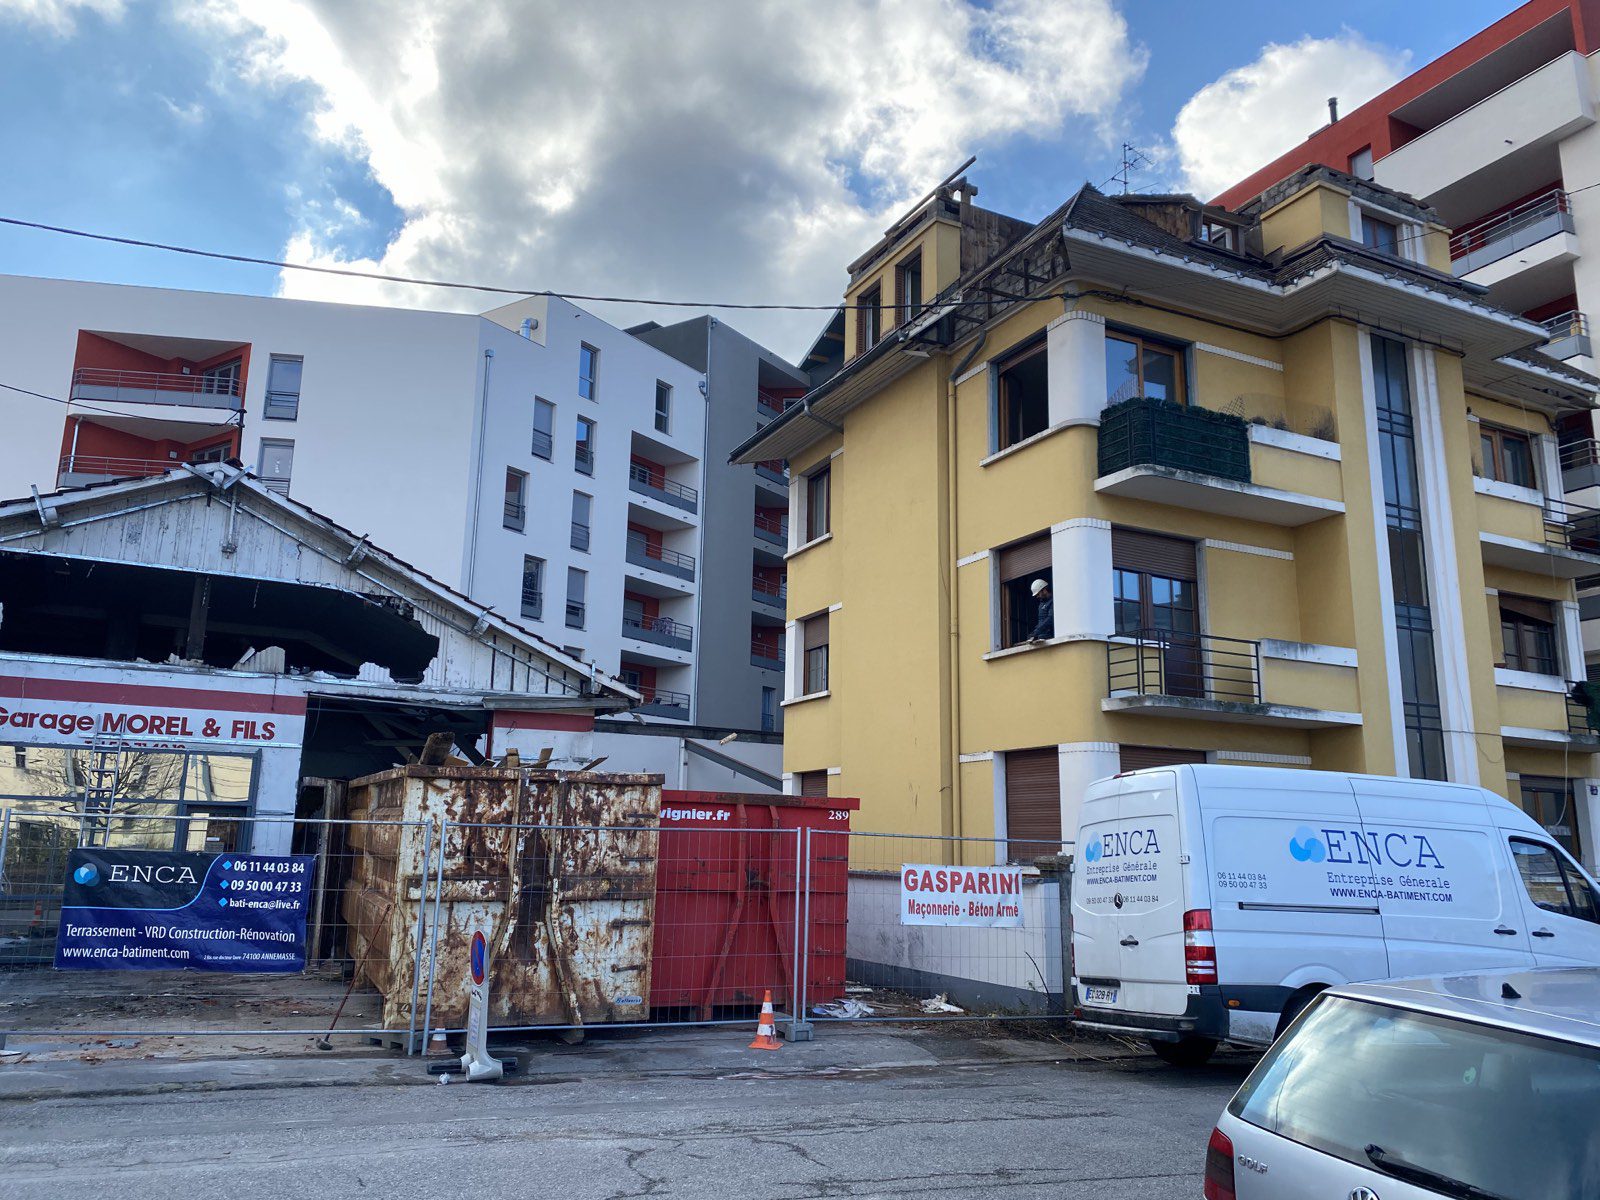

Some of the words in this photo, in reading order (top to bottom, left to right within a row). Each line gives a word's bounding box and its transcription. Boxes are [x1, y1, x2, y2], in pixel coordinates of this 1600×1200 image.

[102, 712, 193, 736] MOREL
[202, 718, 221, 738] &
[231, 720, 276, 740] FILS
[828, 810, 849, 821] 289
[1102, 829, 1161, 858] ENCA
[1321, 829, 1445, 869] ENCA
[108, 864, 198, 884] ENCA
[233, 860, 247, 872] 06
[249, 861, 261, 872] 11
[262, 862, 276, 873] 44
[277, 862, 290, 873] 03
[291, 862, 305, 874] 84
[903, 869, 1020, 895] GASPARINI
[1217, 871, 1227, 880] 06
[1227, 872, 1236, 880] 11
[1237, 872, 1247, 880] 44
[1247, 873, 1257, 881] 03
[1326, 872, 1394, 888] Entreprise
[230, 879, 245, 891] 09
[245, 880, 259, 891] 50
[260, 881, 273, 892] 00
[274, 881, 288, 892] 47
[289, 881, 302, 893] 33
[1218, 880, 1228, 888] 09
[1228, 880, 1238, 888] 50
[1239, 881, 1248, 889] 00
[1330, 887, 1453, 903] WWW.ENCA-BATIMENT.COM
[229, 897, 301, 910] bati-enca@live.fr
[908, 899, 960, 919] Maçonnerie
[968, 901, 994, 917] Béton
[996, 902, 1019, 918] Armé
[66, 924, 137, 937] Terrassement
[145, 926, 167, 939] VRD
[168, 926, 296, 943] Construction-Rénovation
[62, 945, 190, 960] www.enca-batiment.com
[242, 952, 260, 960] 74100
[260, 952, 296, 960] ANNEMASSE
[1238, 1154, 1268, 1174] GOLF
